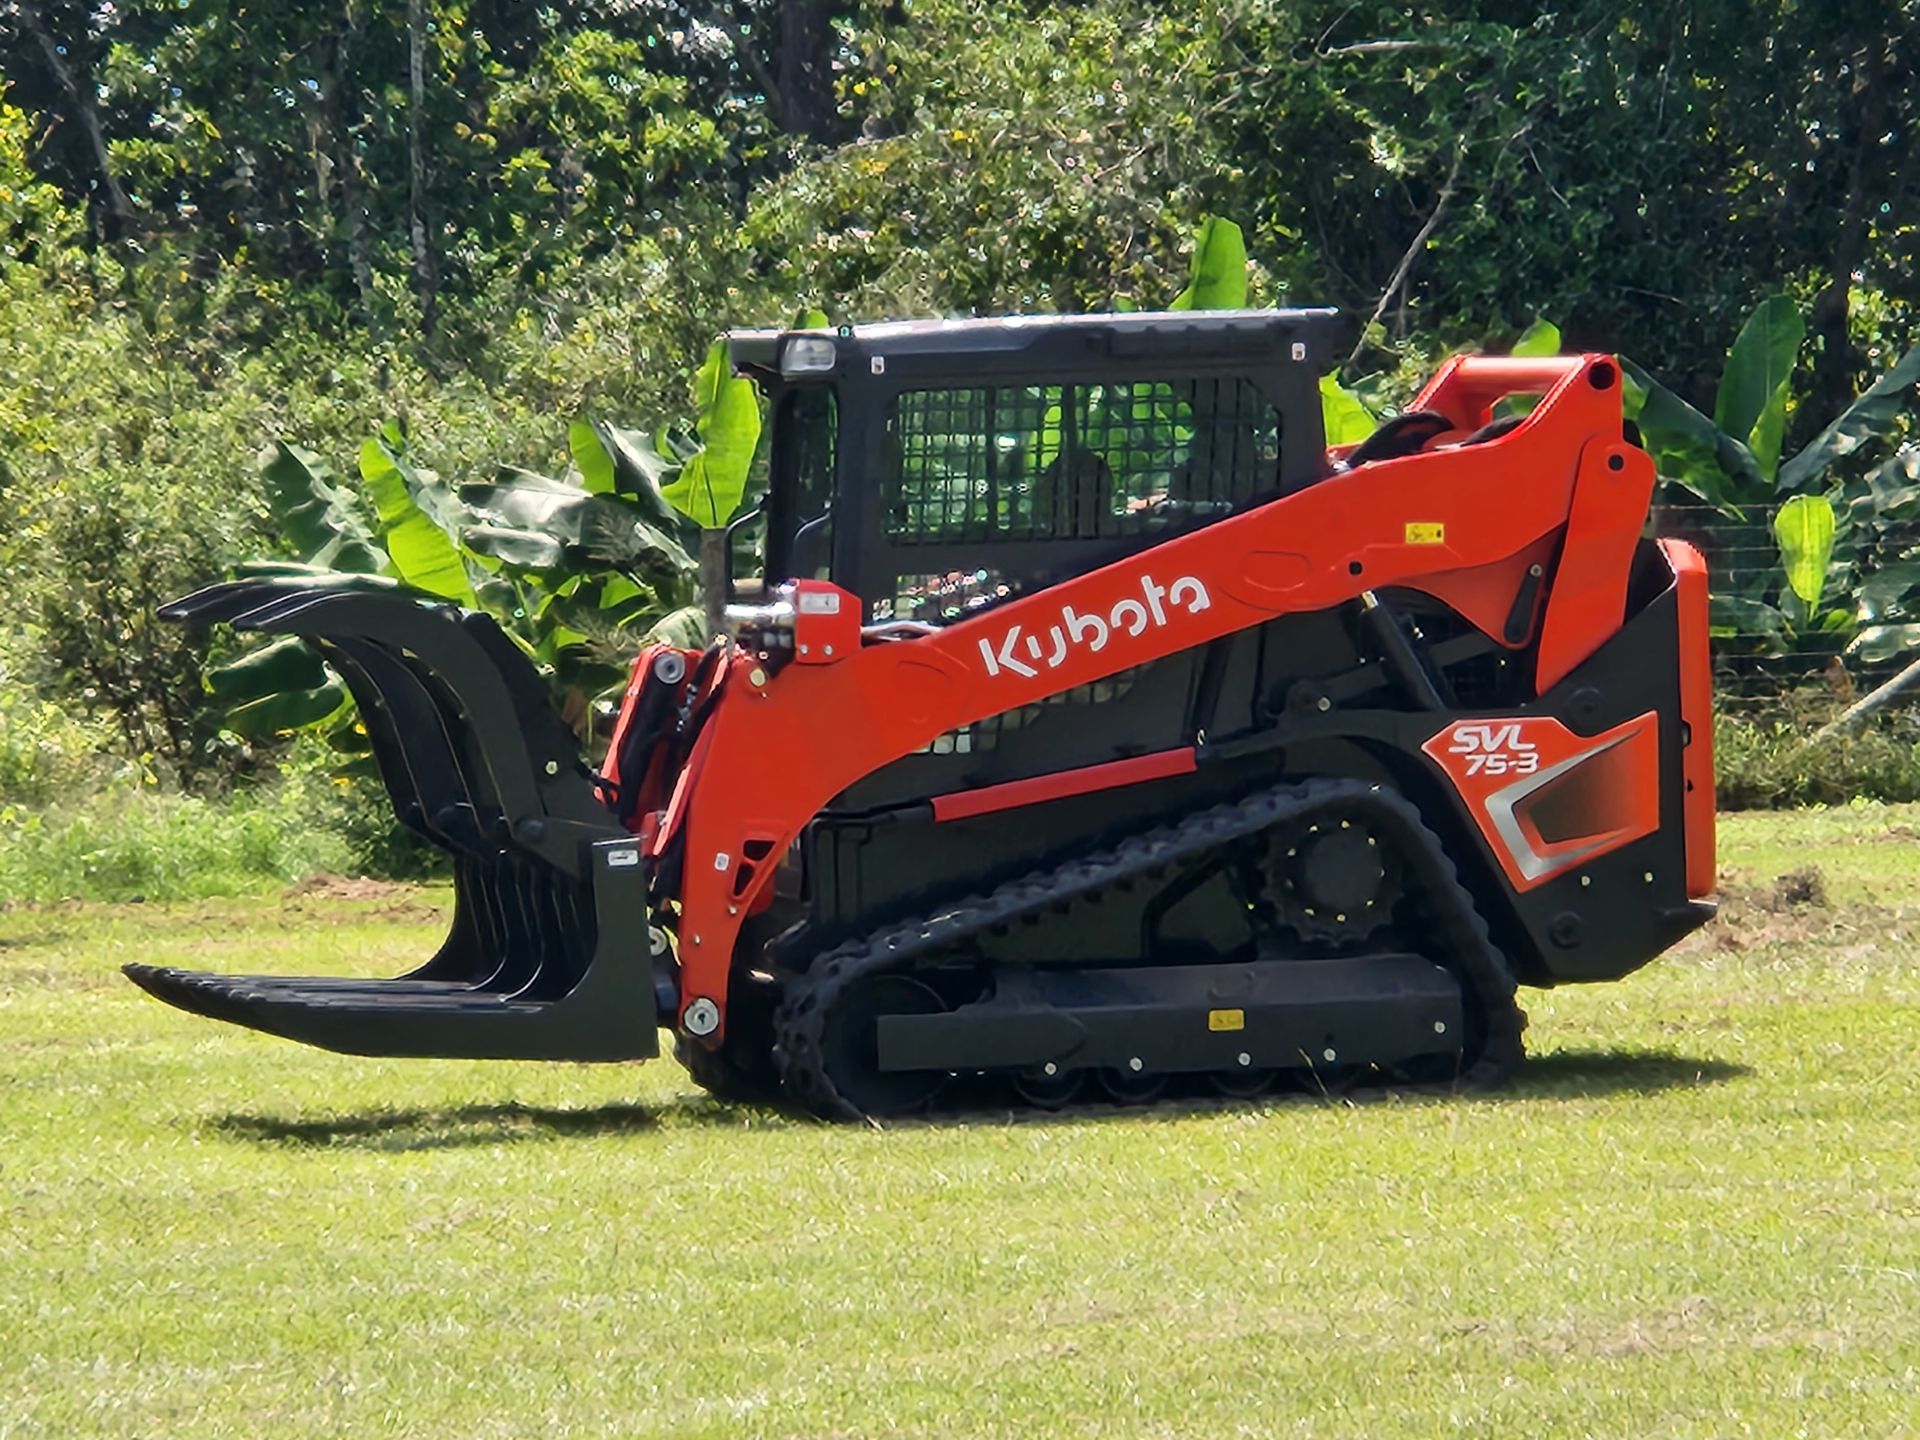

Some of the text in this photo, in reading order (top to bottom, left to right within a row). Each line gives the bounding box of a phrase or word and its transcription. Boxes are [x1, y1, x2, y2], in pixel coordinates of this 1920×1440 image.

[978, 575, 1211, 678] Kubota
[1448, 724, 1536, 753] SVL
[1465, 752, 1539, 776] 75-3
